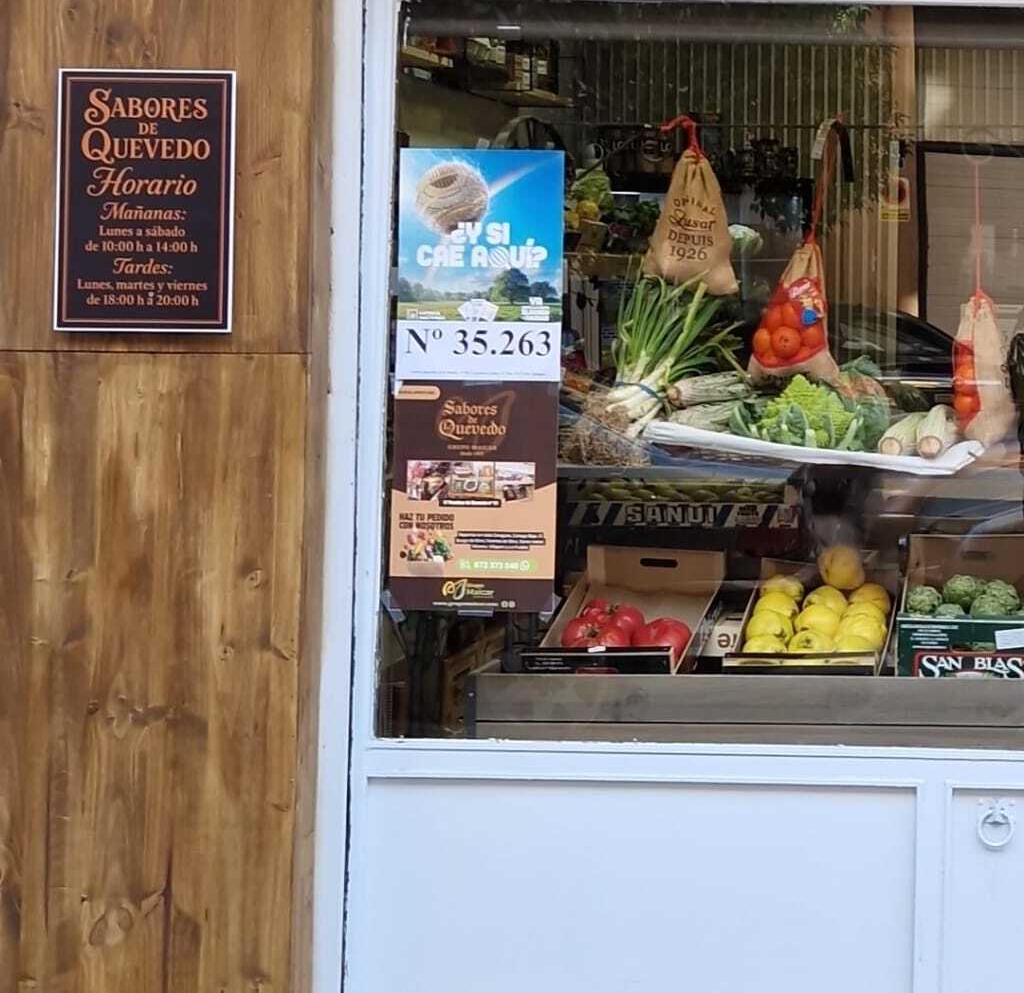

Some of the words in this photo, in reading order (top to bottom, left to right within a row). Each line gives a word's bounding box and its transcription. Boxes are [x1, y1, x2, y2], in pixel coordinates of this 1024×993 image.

[138, 122, 159, 135] DE
[86, 166, 198, 196] Horario
[100, 202, 187, 220] Mañanas:
[99, 225, 134, 237] Lunes
[135, 228, 143, 237] a
[145, 225, 186, 237] sábado
[485, 222, 511, 245] SI
[84, 240, 99, 252] de
[102, 241, 134, 252] 10:00
[136, 241, 144, 252] h
[146, 244, 153, 252] a
[155, 241, 188, 253] 14:00
[190, 241, 198, 253] h
[416, 245, 465, 268] CAE
[112, 257, 174, 274] Tardes:
[116, 280, 155, 291] martes
[157, 282, 164, 293] y
[167, 279, 208, 291] viernes
[86, 294, 100, 305] de
[103, 294, 135, 306] 18:00
[137, 294, 145, 305] h
[157, 294, 190, 306] 20:00
[191, 294, 199, 306] h
[453, 328, 551, 356] 35.263
[443, 399, 498, 415] Sabores
[438, 418, 507, 440] Quevedo
[918, 655, 964, 678] SAN
